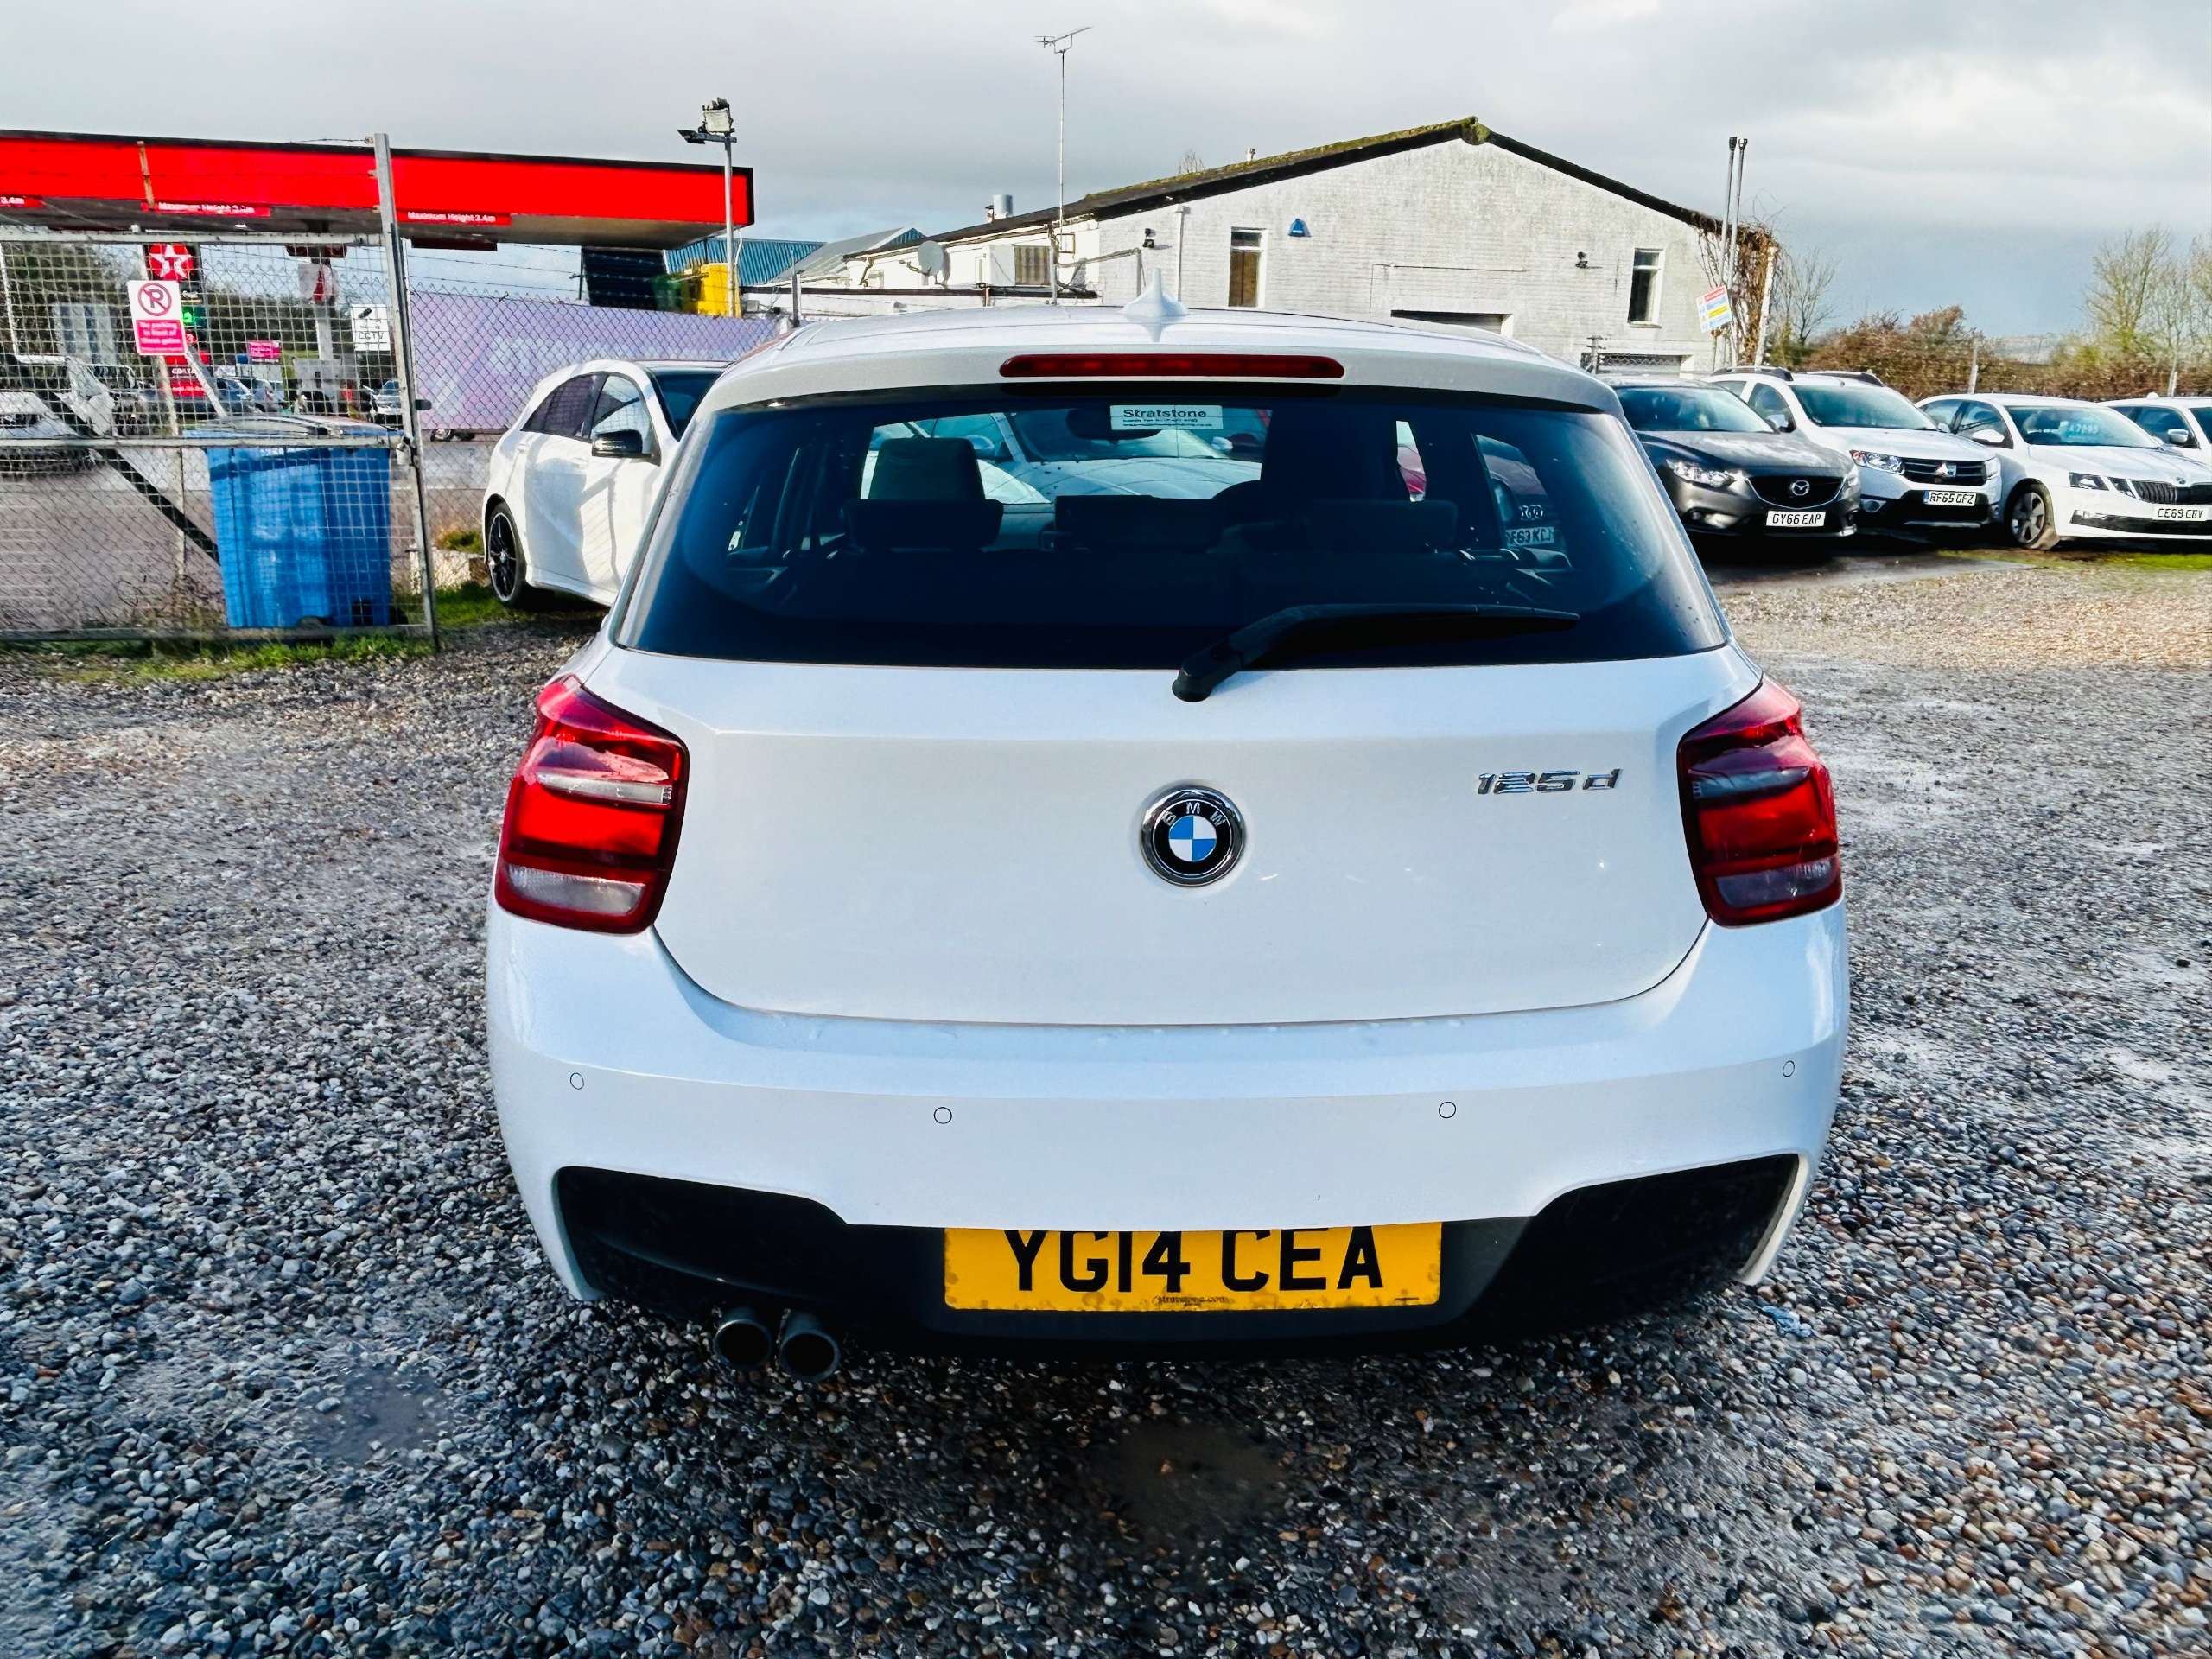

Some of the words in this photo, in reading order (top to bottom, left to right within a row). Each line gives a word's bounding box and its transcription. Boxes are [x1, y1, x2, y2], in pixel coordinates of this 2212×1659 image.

[407, 211, 447, 220] Maximum
[448, 213, 474, 223] Height
[1123, 409, 1206, 418] Stratstone
[1772, 513, 1800, 524] GY66
[1802, 513, 1821, 524] EAP
[2158, 508, 2183, 518] CE69
[1161, 801, 1228, 827] BMW
[1003, 1230, 1191, 1293] YG14
[1221, 1225, 1383, 1292] CEA
